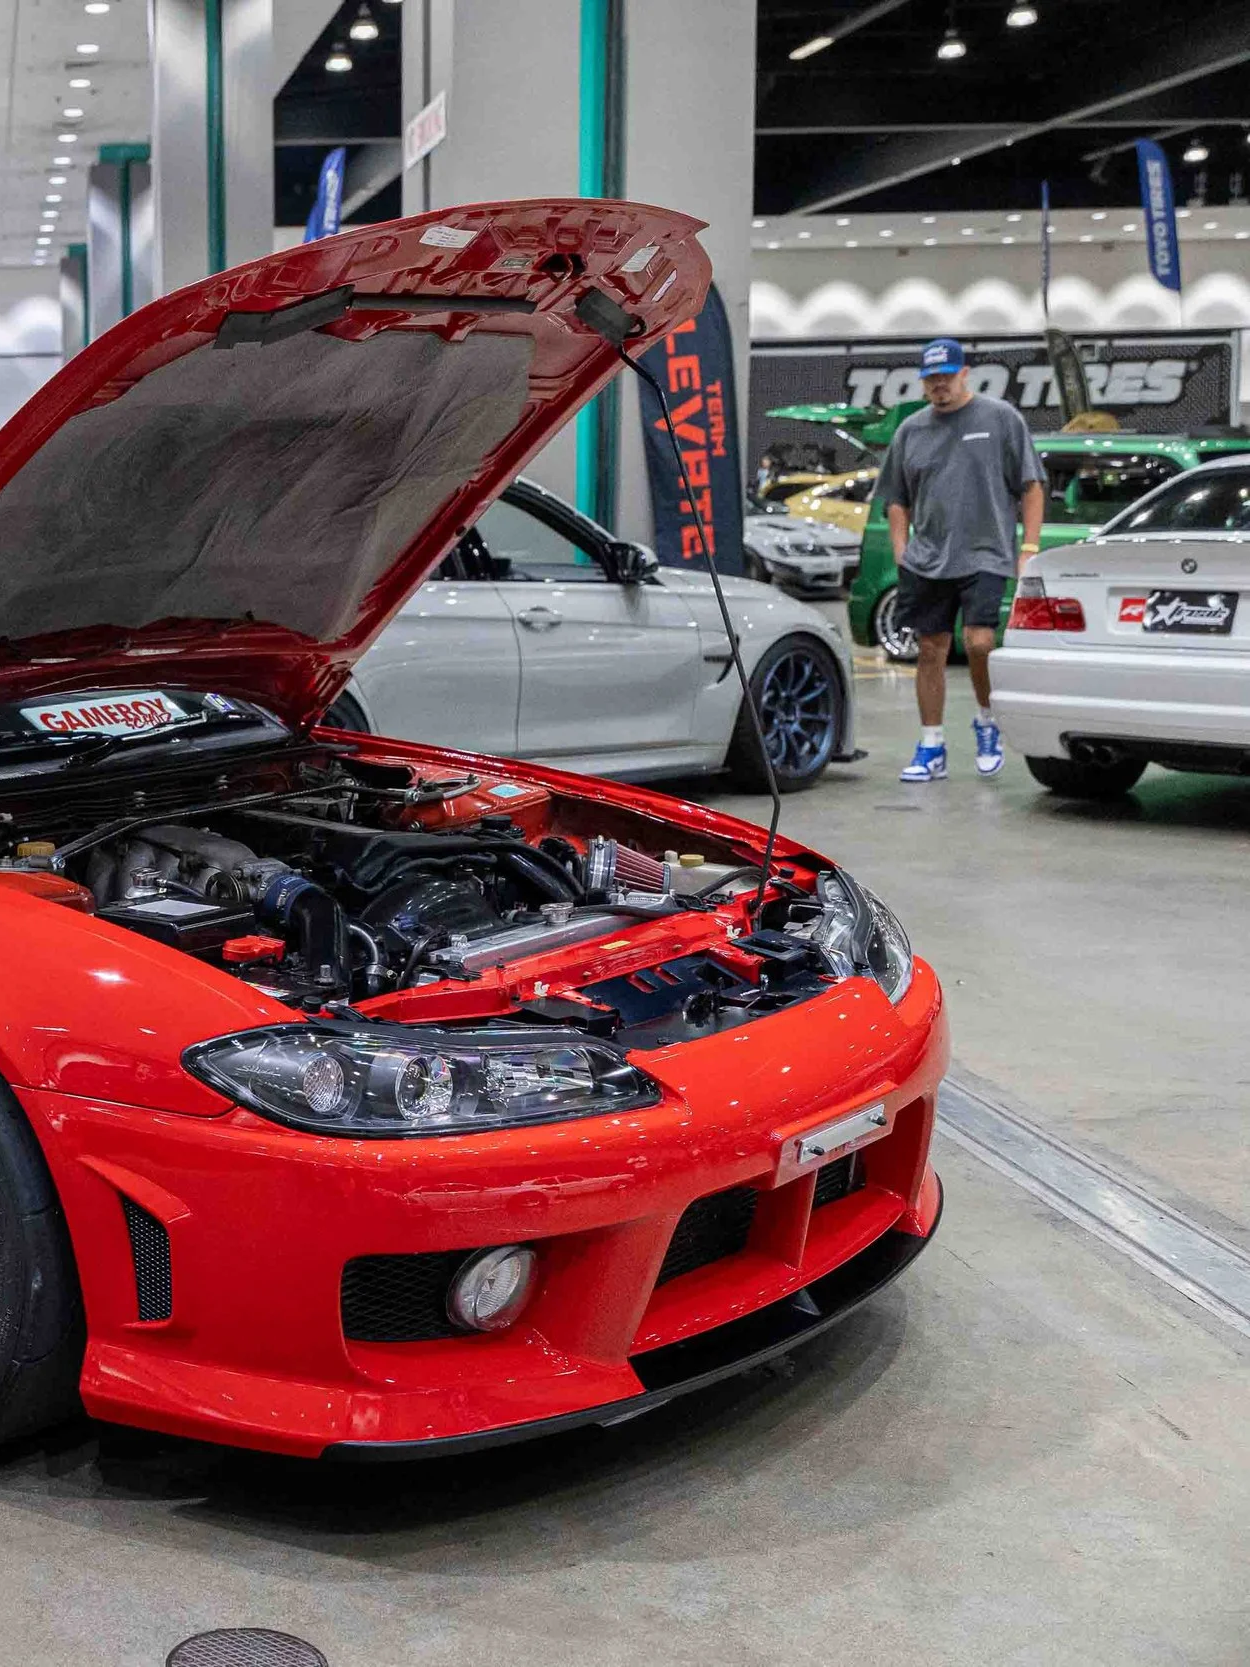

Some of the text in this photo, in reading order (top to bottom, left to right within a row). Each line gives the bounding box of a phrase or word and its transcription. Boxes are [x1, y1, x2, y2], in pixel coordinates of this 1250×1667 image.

[847, 364, 1010, 408] TOO
[706, 379, 727, 457] TEAM
[39, 698, 168, 732] GAMEBOY
